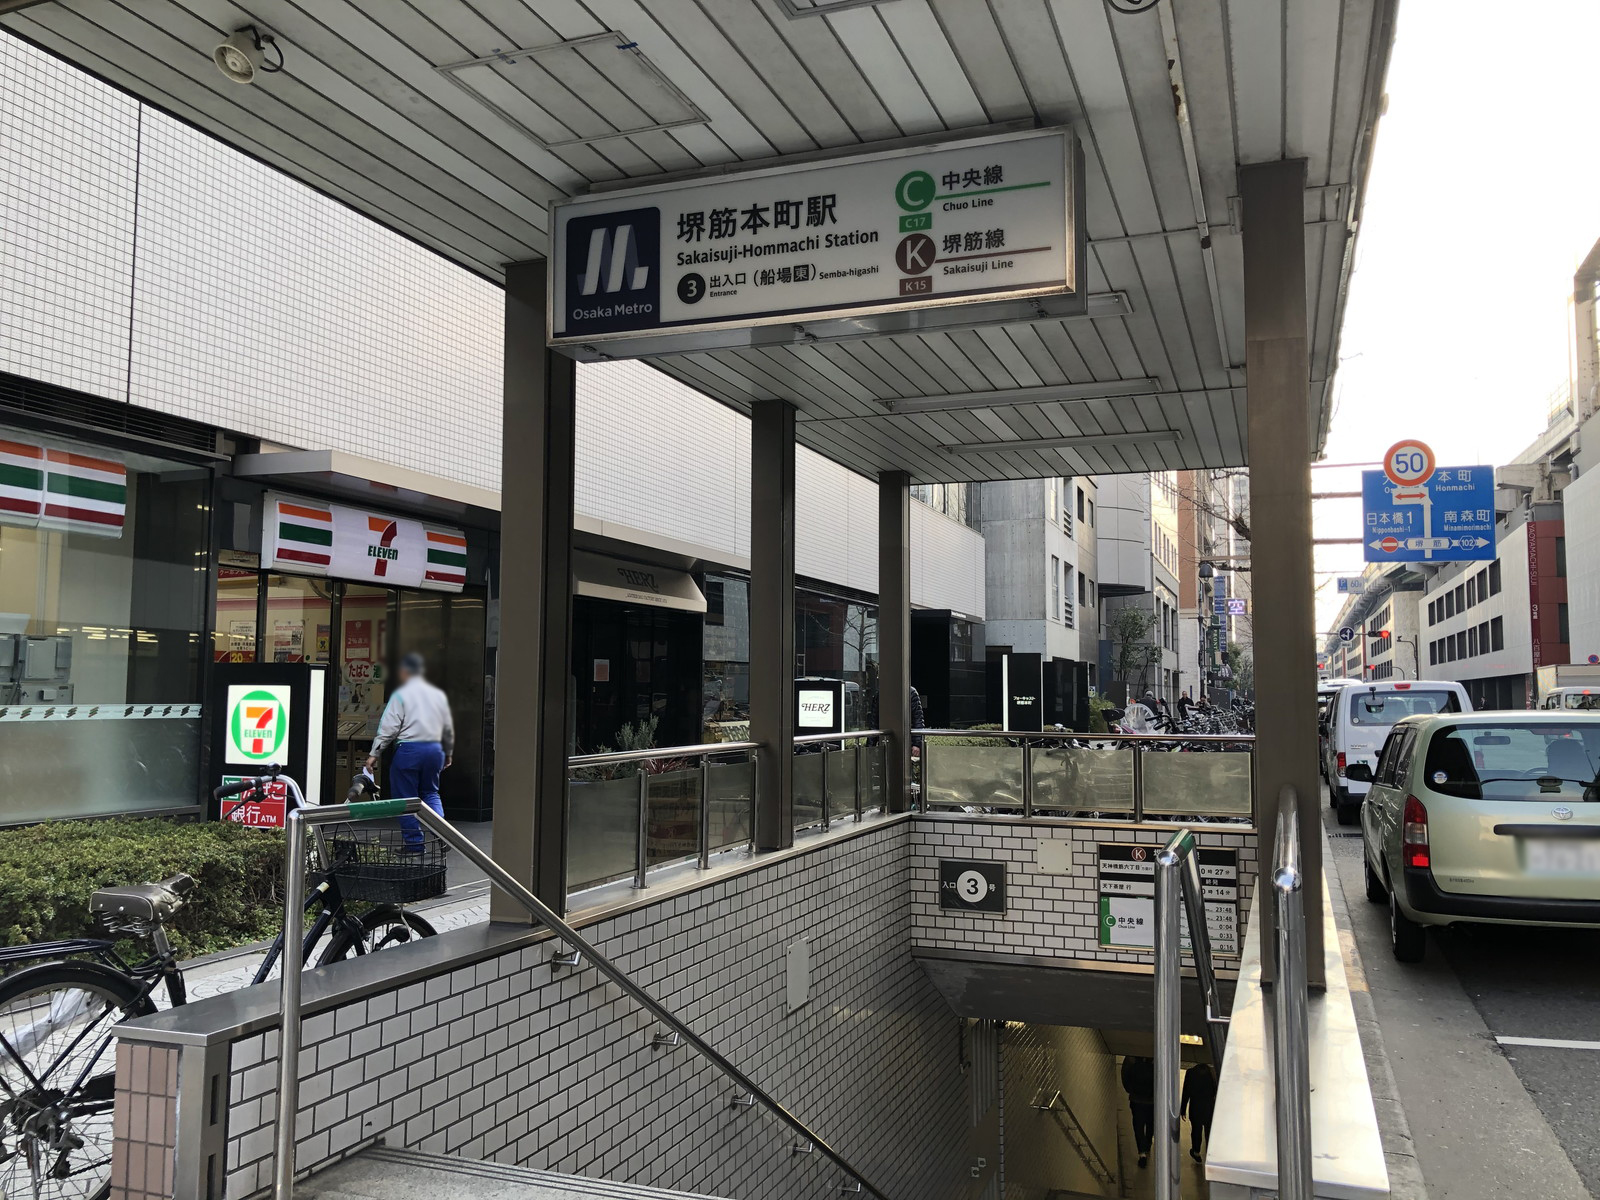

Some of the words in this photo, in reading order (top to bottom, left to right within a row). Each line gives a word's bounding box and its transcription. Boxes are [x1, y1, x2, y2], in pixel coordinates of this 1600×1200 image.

[942, 165, 1003, 190] 中央線
[903, 176, 925, 206] C
[943, 200, 968, 211] Chuo
[971, 198, 993, 208] Line
[676, 194, 837, 243] 堺筋本町駅
[905, 217, 926, 229] C17
[677, 233, 820, 266] Sakaisuji-Hommachi
[824, 230, 879, 249] Station
[942, 228, 1005, 254] 堺筋線
[905, 239, 926, 270] K
[819, 265, 879, 280] Semba-higashi
[943, 262, 988, 276] Sakaisuji
[991, 260, 1014, 270] Line
[686, 280, 698, 298] 3
[709, 273, 746, 289] 出入口
[905, 281, 926, 291] K15
[709, 288, 738, 298] Entrance
[573, 305, 612, 320] Osaka
[614, 303, 652, 316] Metro
[1395, 453, 1424, 474] 50
[1437, 470, 1472, 482] 本町
[1435, 484, 1475, 492] Honmachi
[1444, 509, 1490, 523] 南森町
[1443, 523, 1491, 532] Minamimorimachi
[1461, 538, 1474, 547] 102
[1228, 600, 1245, 614] 空
[349, 664, 370, 677] たばこ
[801, 703, 831, 714] HERZ
[1135, 850, 1142, 859] K
[942, 881, 956, 889] 入口
[966, 878, 979, 895] 3
[988, 883, 996, 892] 号
[1118, 917, 1144, 925] 中央線
